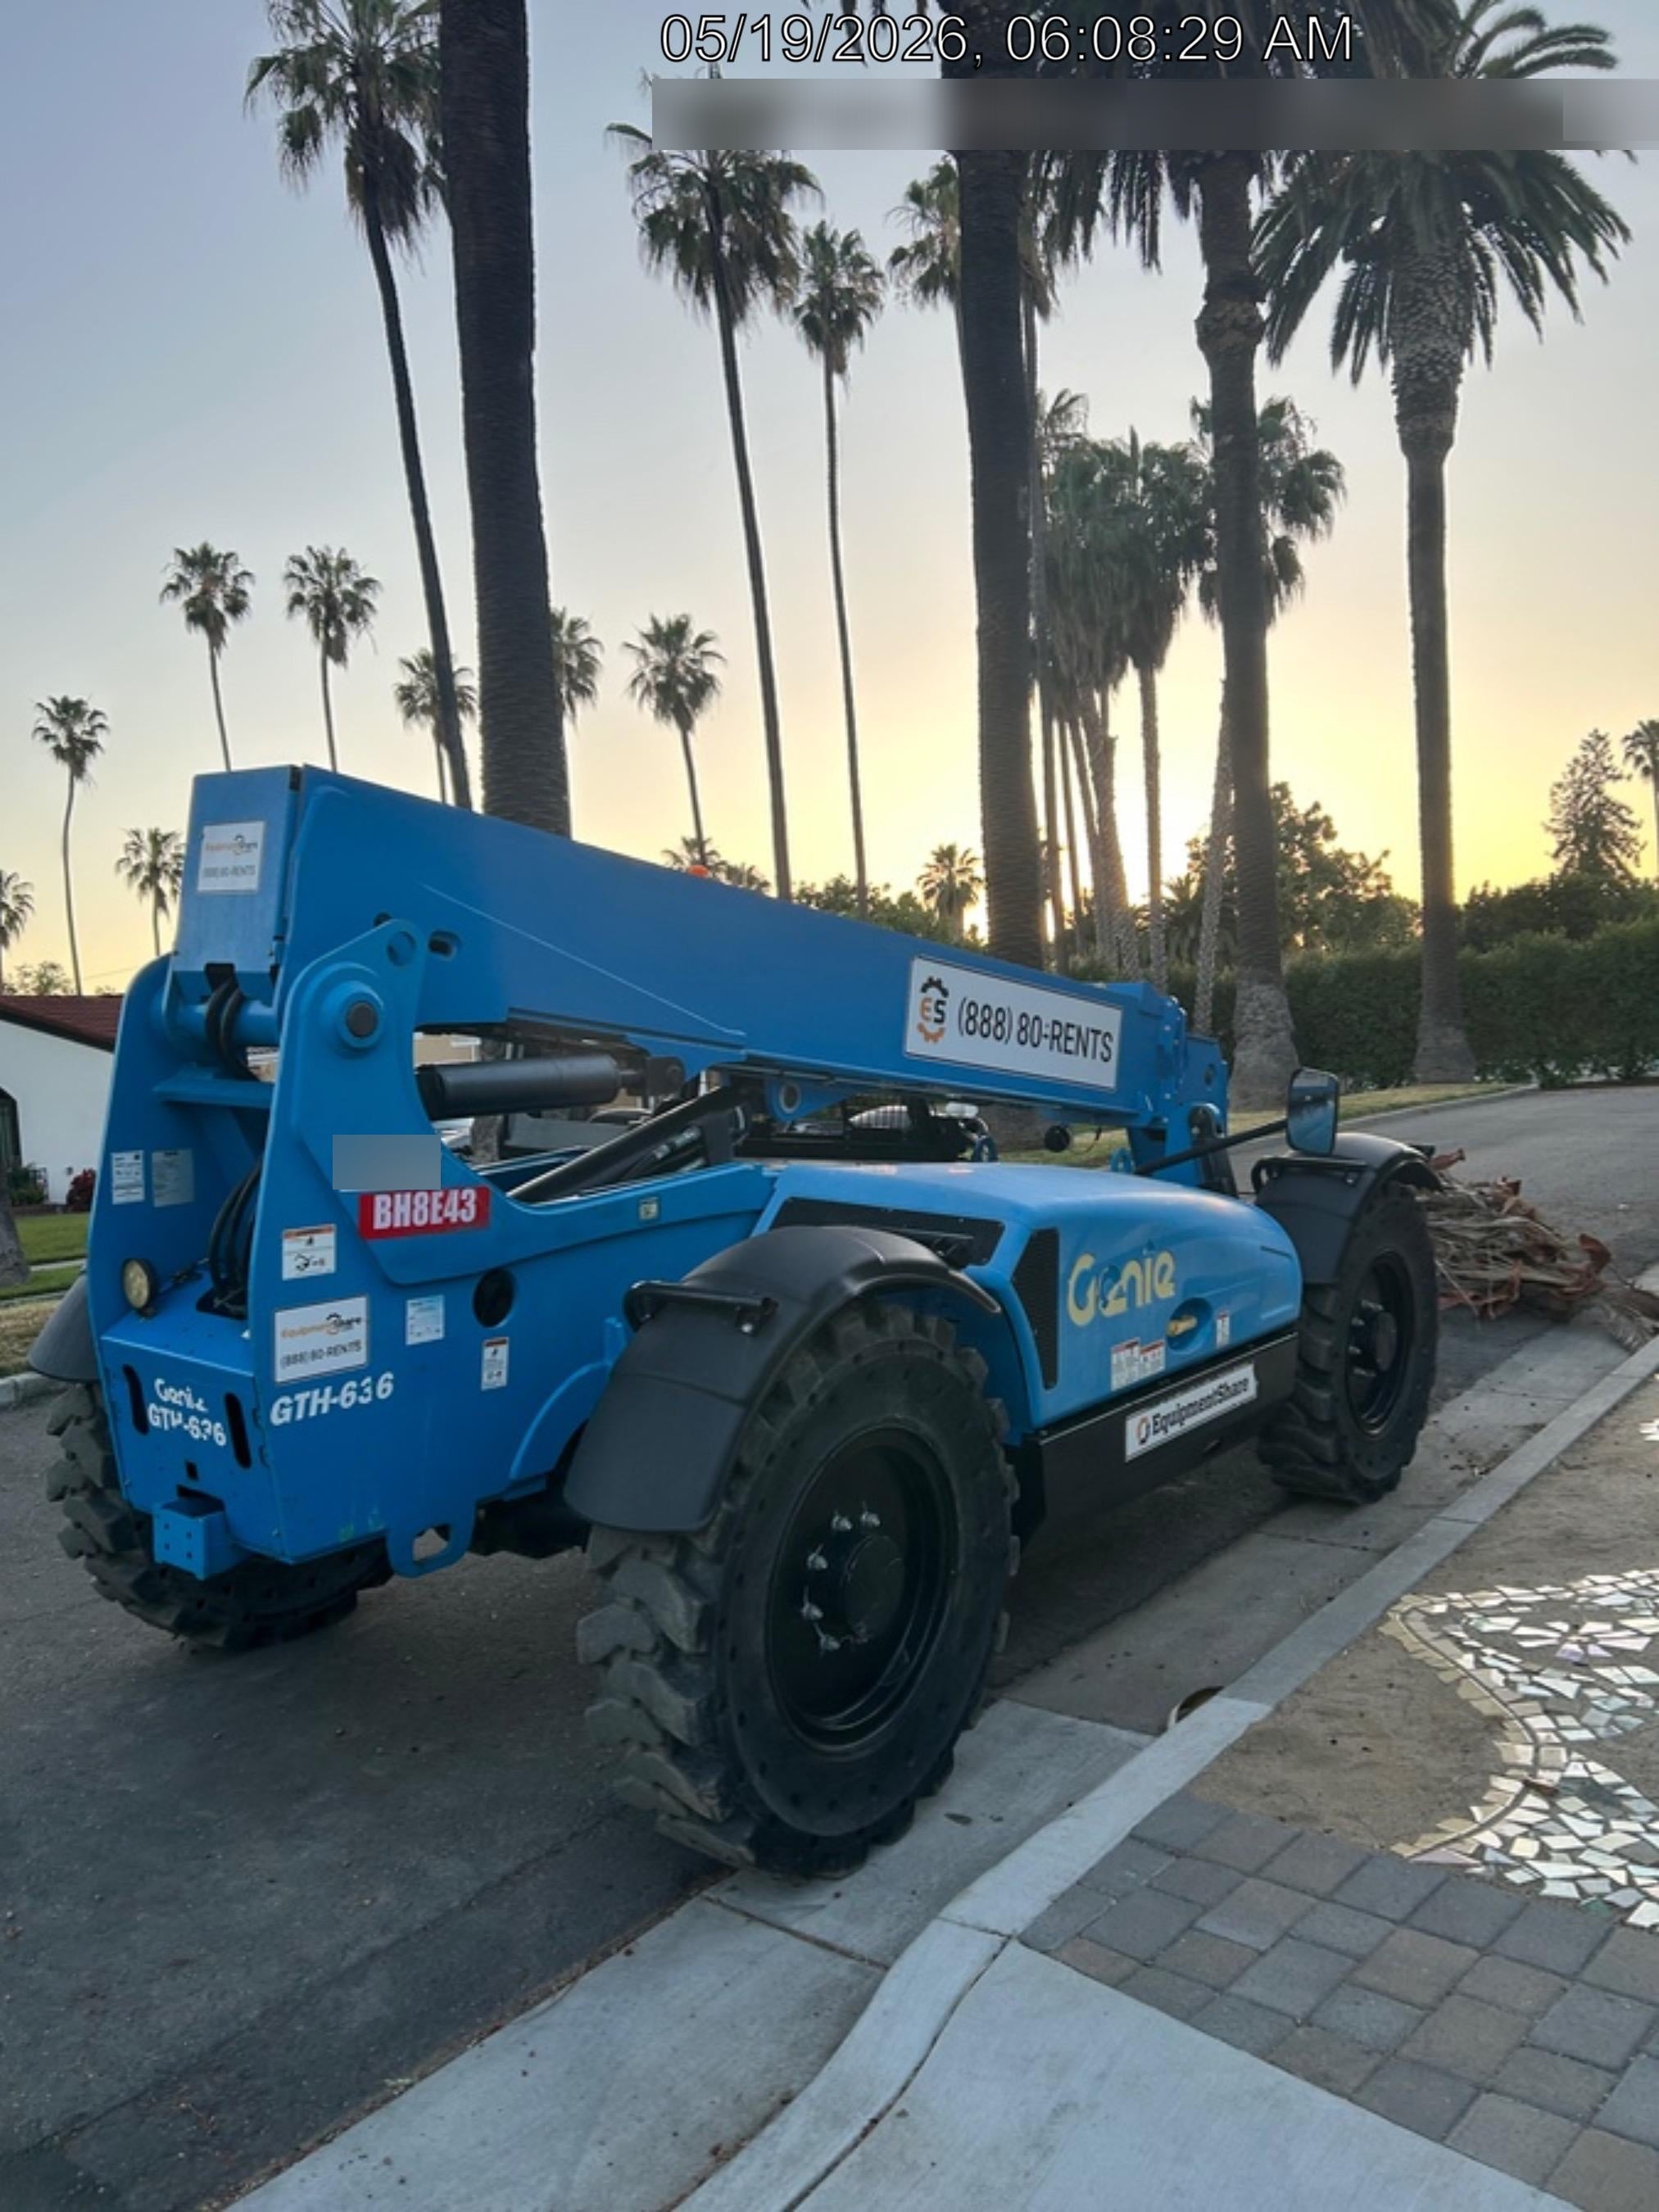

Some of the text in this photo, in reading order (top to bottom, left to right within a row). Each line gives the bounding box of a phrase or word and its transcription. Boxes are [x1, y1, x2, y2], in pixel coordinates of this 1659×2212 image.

[958, 997, 1113, 1063] (888) 80-RENTS
[373, 1188, 477, 1230] BH8E43
[1068, 1249, 1176, 1326] Genie
[270, 1371, 394, 1426] GTH-636
[1152, 1378, 1249, 1434] EquipmentShare
